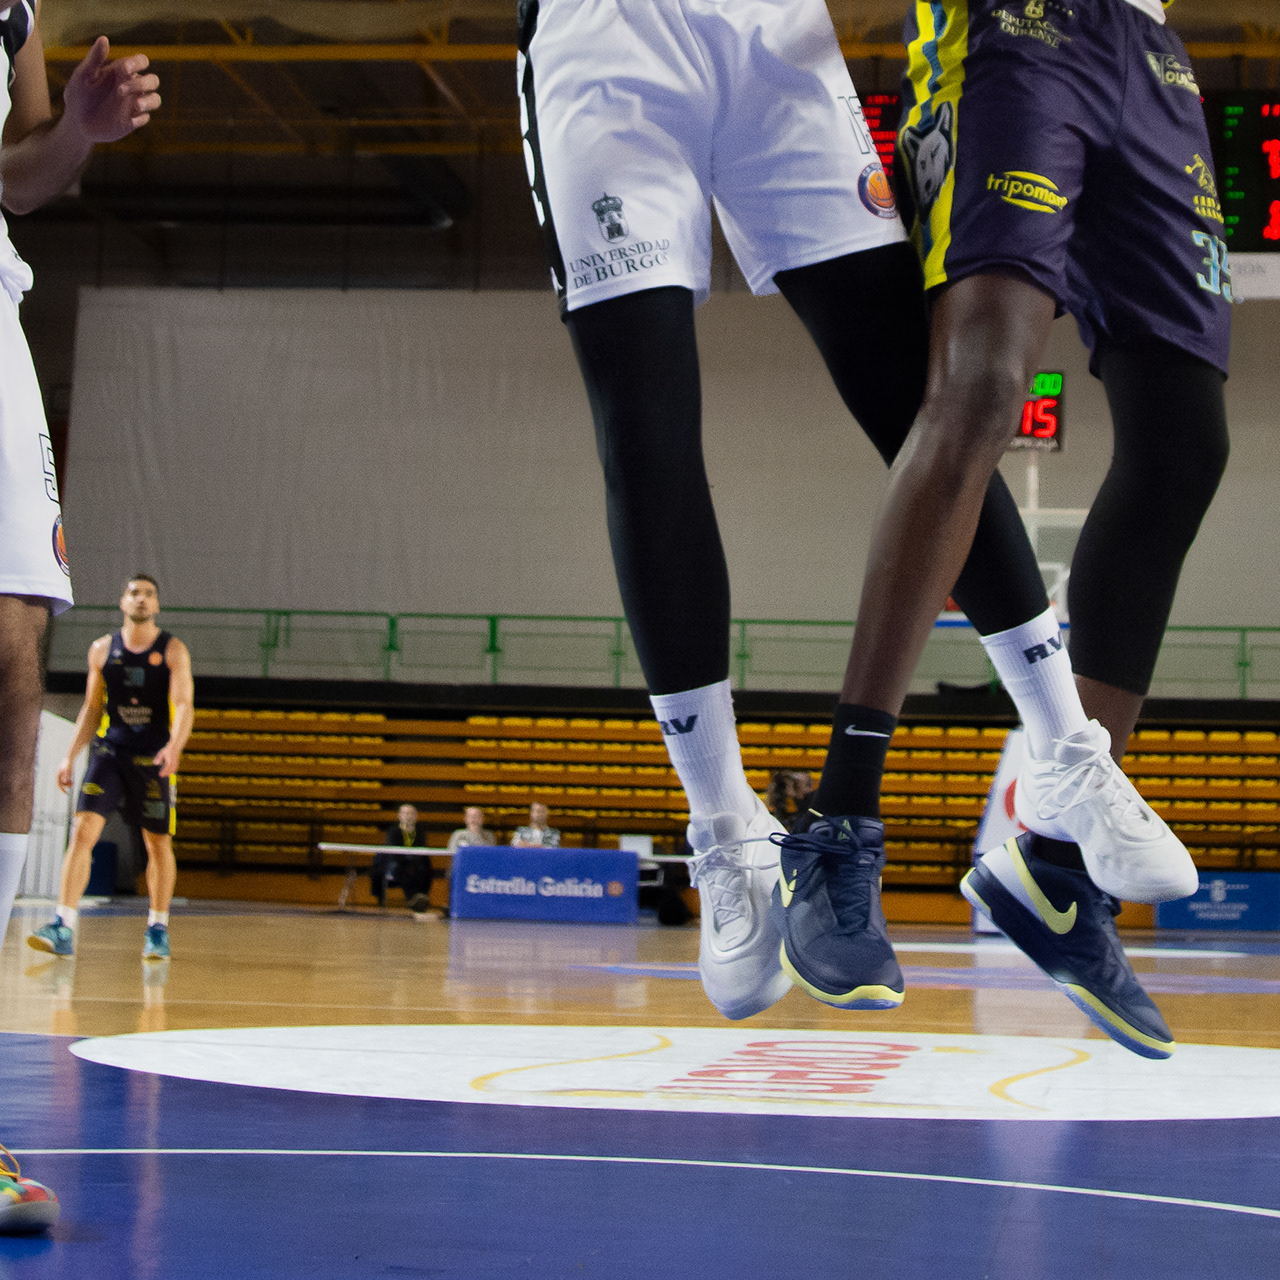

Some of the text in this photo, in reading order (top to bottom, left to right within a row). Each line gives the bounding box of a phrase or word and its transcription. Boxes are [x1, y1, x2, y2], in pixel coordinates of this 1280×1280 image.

[570, 239, 670, 273] UNIVERSIDAD
[574, 273, 592, 289] DE
[1022, 398, 1058, 438] 15
[466, 874, 604, 898] Estrella Galicia
